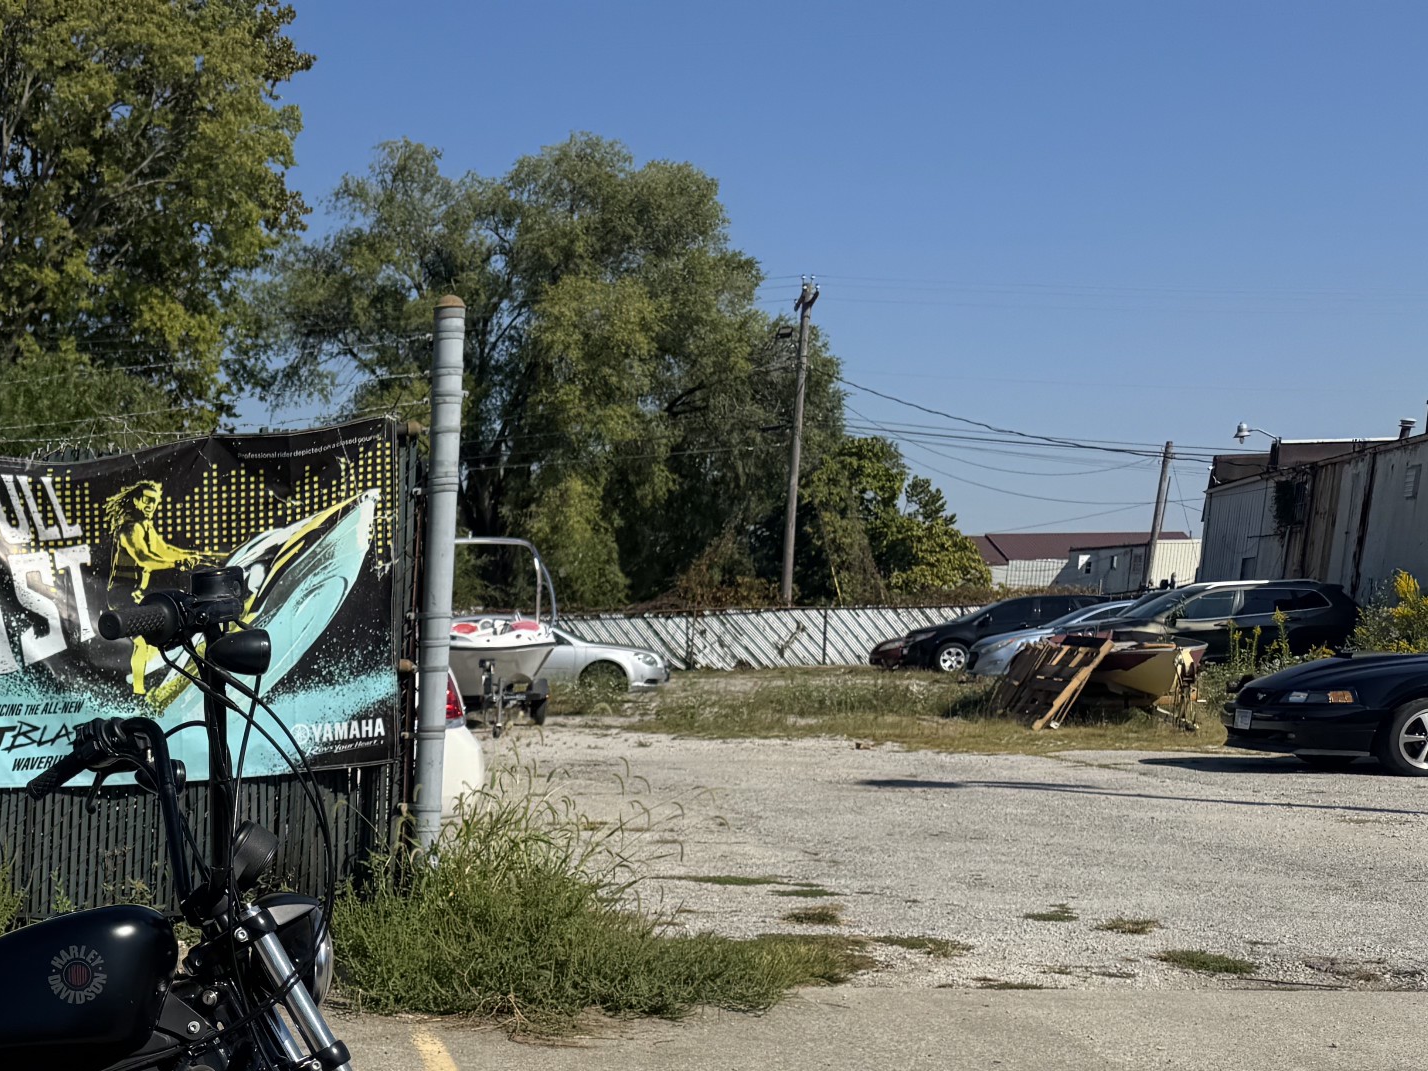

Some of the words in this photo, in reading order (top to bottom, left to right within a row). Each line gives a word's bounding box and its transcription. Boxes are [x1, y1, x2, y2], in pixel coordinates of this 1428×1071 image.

[237, 450, 277, 459] Professional
[277, 450, 293, 459] rider
[293, 445, 322, 458] depicted
[336, 436, 357, 448] closed
[24, 704, 40, 716] THE
[40, 700, 85, 715] ALL-NEW
[312, 718, 386, 743] YAMAHA
[50, 945, 105, 970] HARLEY
[47, 972, 108, 1005] DAVIDSON
